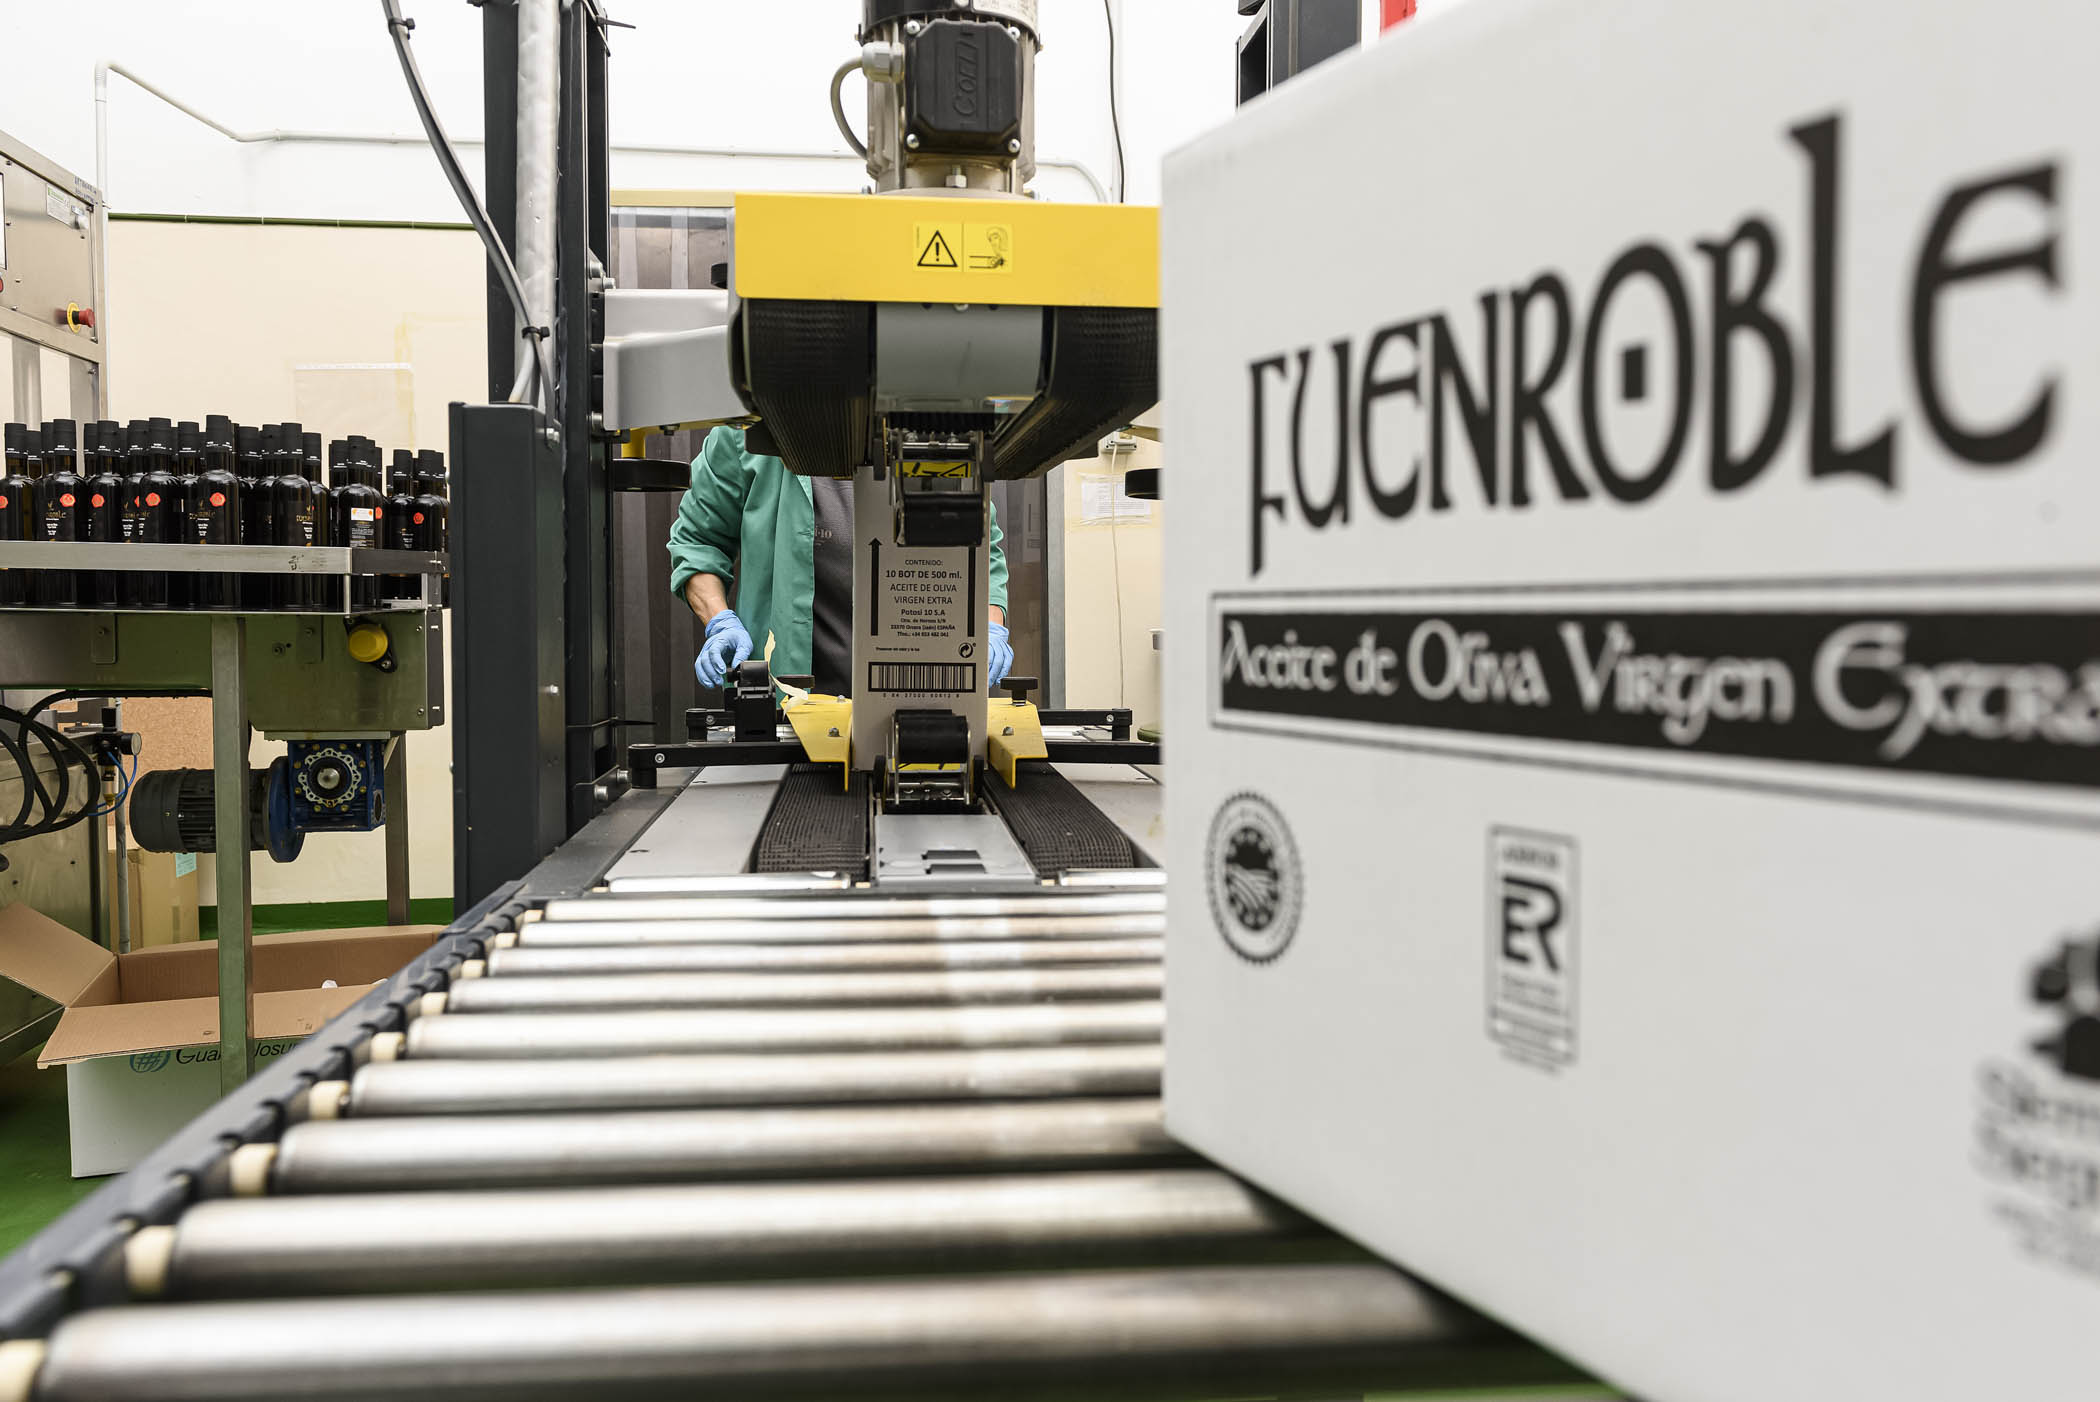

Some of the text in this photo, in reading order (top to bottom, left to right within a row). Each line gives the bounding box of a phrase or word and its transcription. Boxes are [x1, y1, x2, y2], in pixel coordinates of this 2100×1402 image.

[1249, 109, 2065, 578] FUENROBLE
[885, 570, 962, 579] 10 BOT DE 500 ml.
[890, 583, 957, 593] ACEITE DE OLIVA
[894, 596, 953, 605] VIRGEN EXTRA
[1222, 618, 1338, 692] Aceite
[1343, 626, 1399, 696] de
[1406, 617, 1552, 707] Oliva
[1557, 620, 1796, 746] Virgen
[175, 1047, 221, 1064] Gua
